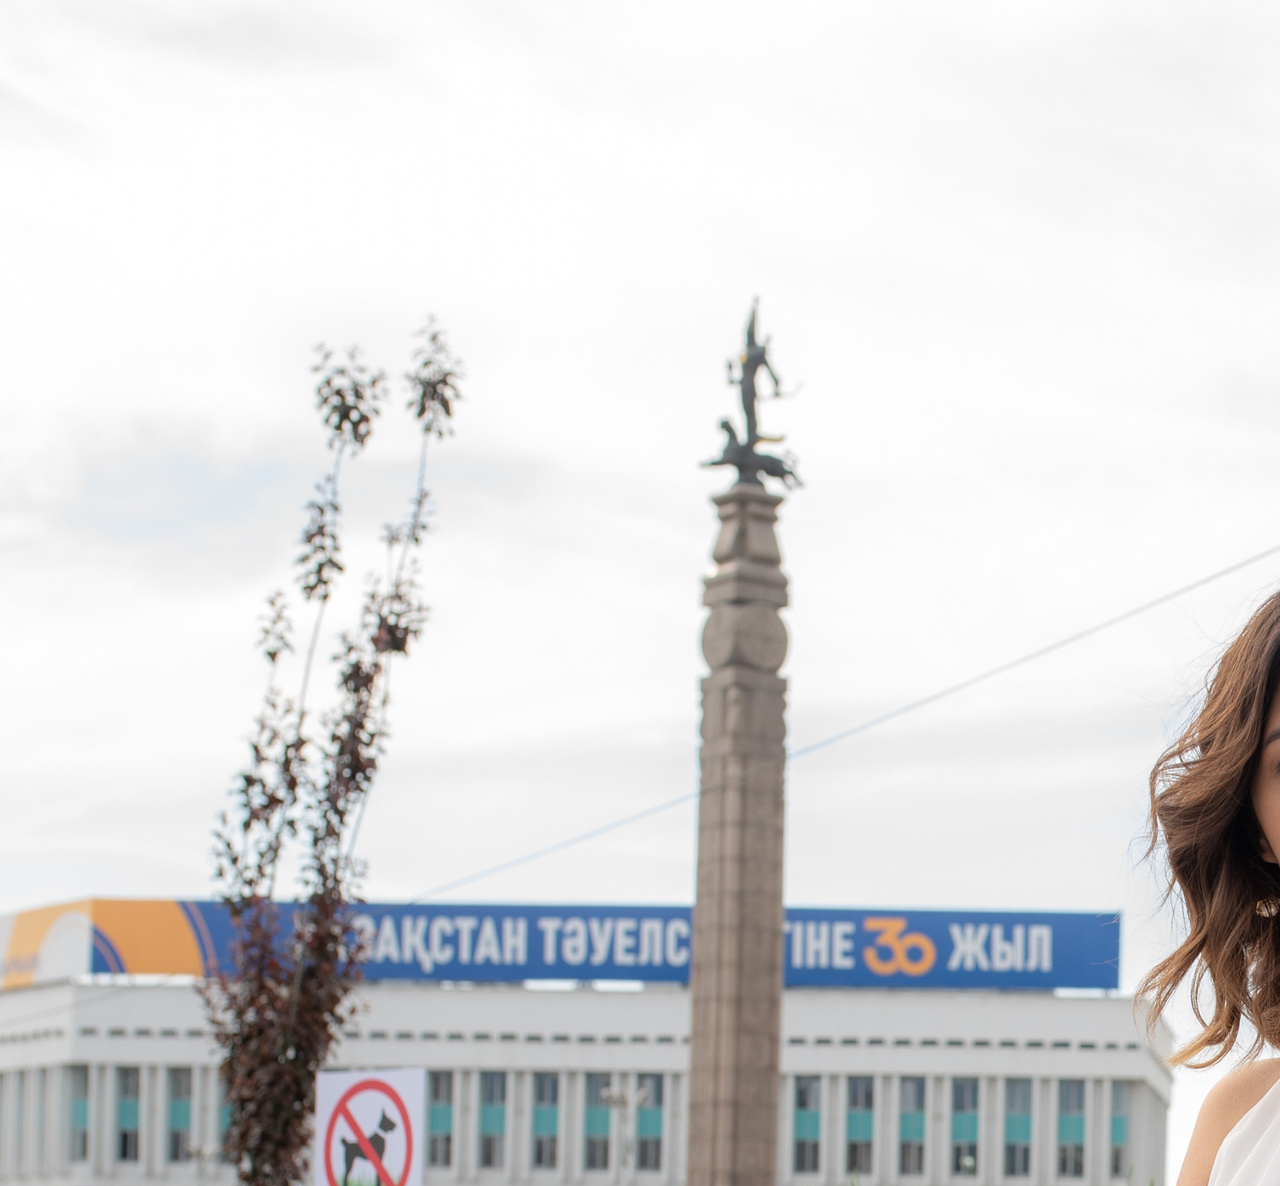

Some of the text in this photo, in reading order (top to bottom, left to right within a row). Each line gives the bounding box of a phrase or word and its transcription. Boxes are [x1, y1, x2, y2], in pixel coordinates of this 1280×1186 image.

[294, 914, 528, 973] ЗАҚСТАН
[863, 916, 937, 977] 30
[947, 923, 1053, 973] ЖЫЛ
